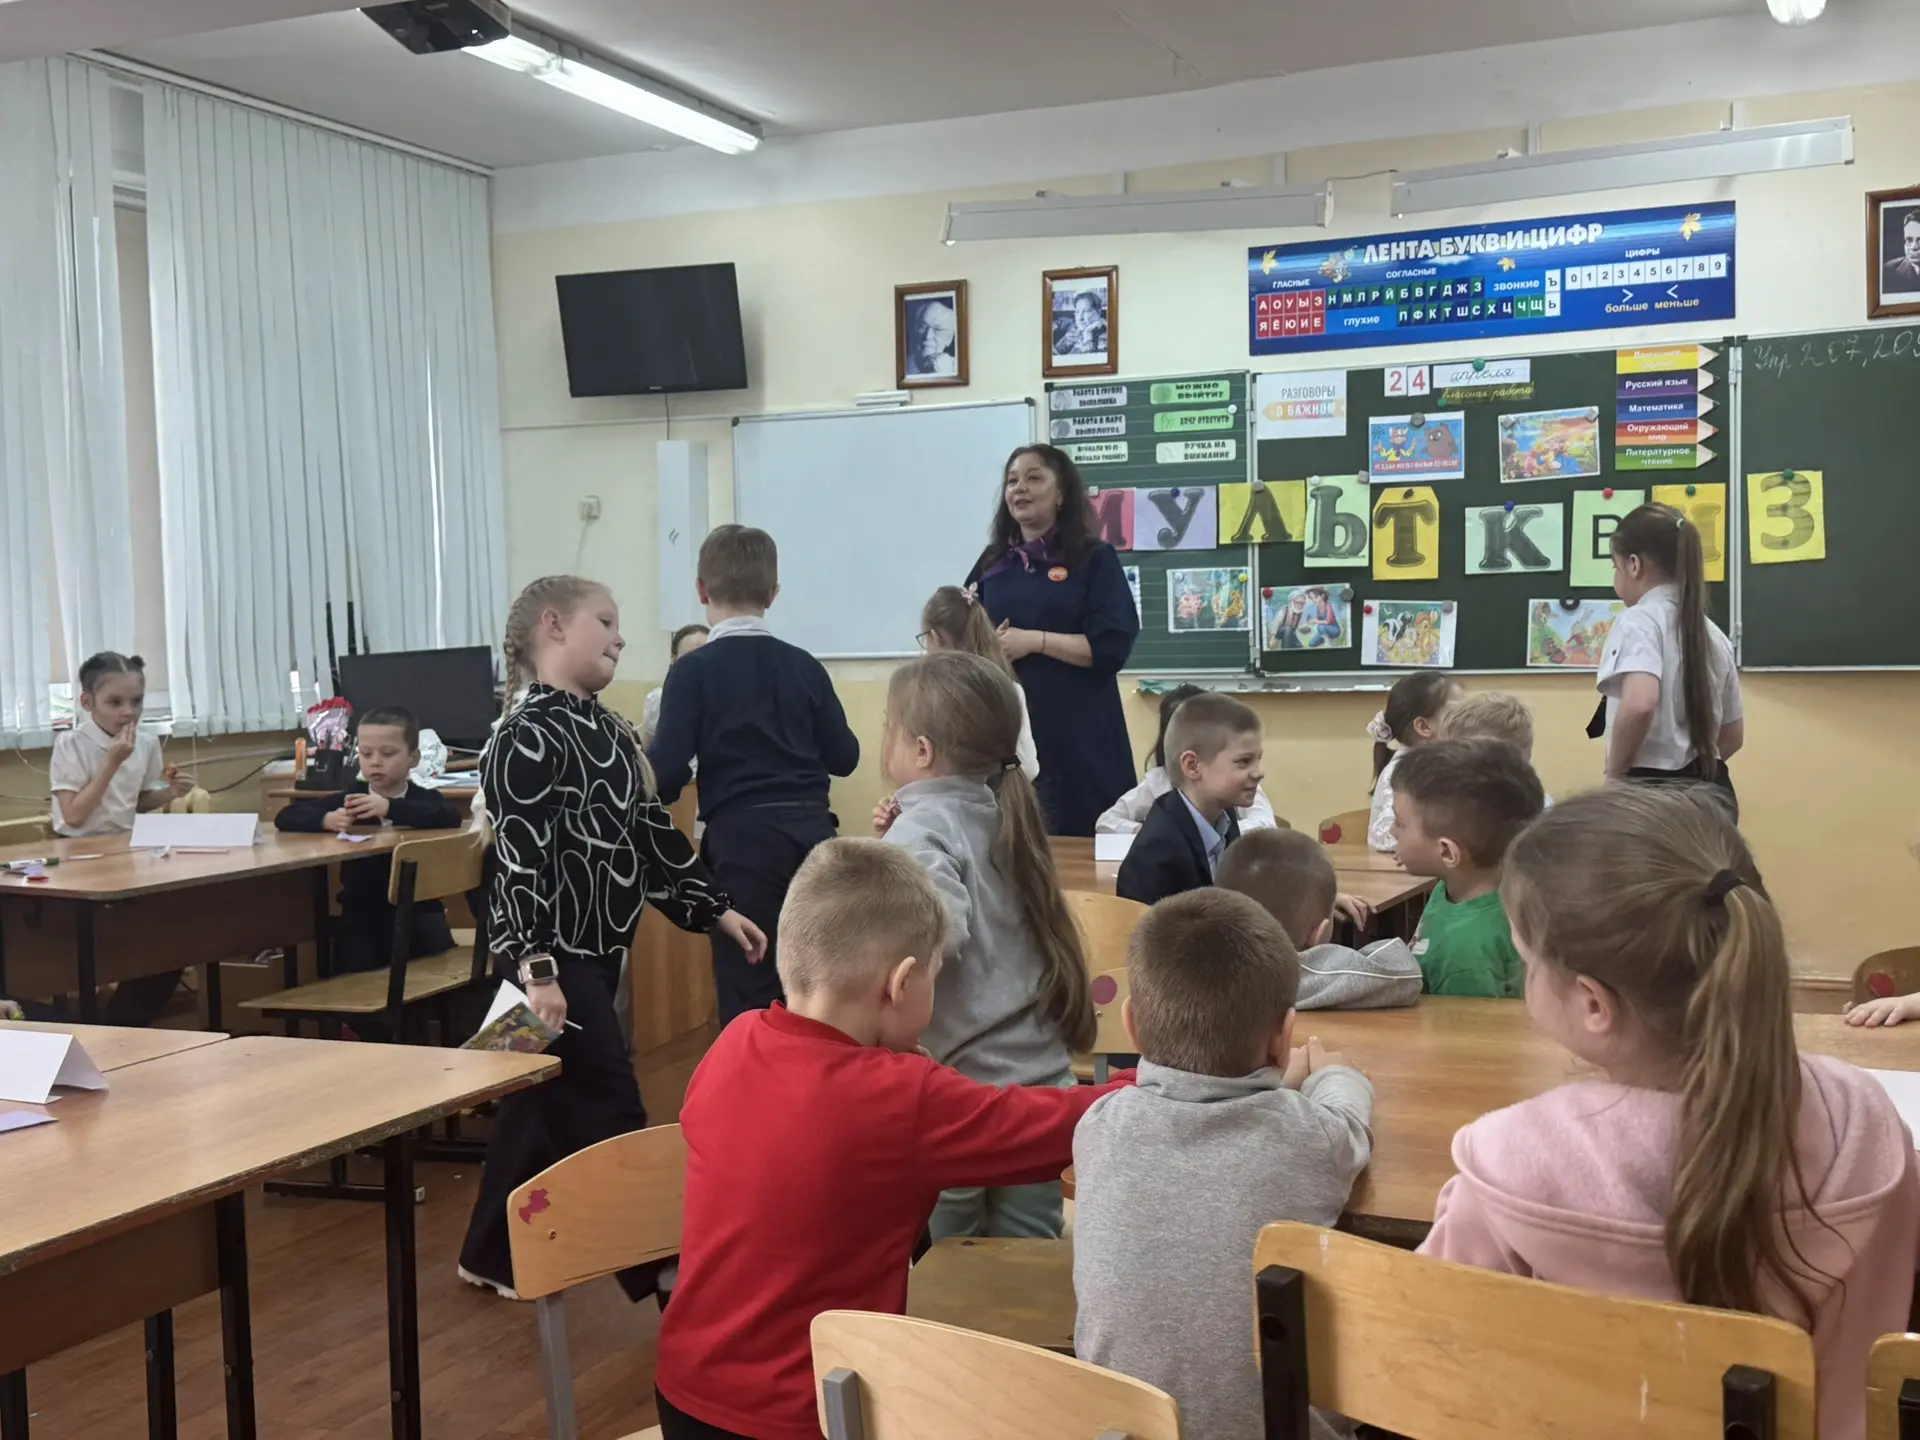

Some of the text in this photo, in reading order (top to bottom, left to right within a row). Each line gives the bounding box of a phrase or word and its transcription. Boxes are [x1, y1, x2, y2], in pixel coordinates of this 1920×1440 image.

[1363, 223, 1603, 264] ЛЕНТА БУКВ И ЦИФР
[1625, 247, 1660, 258] ЦИФРЫ
[1386, 267, 1437, 279] СОГЛАСНЫЕ
[1272, 279, 1311, 288] ГЛАСНЫЕ
[1493, 280, 1540, 291] звонкие
[1605, 298, 1699, 313] больше меньше
[1344, 315, 1380, 327] глухие
[1450, 367, 1514, 384] апреля
[1625, 378, 1688, 390] Русский язык
[1281, 385, 1336, 399] РАЗГОВОРЫ
[1276, 405, 1283, 417] О
[1628, 403, 1684, 412] Математика
[1627, 422, 1689, 433] Окружающий
[1184, 440, 1226, 450] РУЧКА НА
[1184, 451, 1230, 460] ВНИМАНИЕ
[1625, 448, 1690, 457] Литературное
[1642, 458, 1673, 466] чтение
